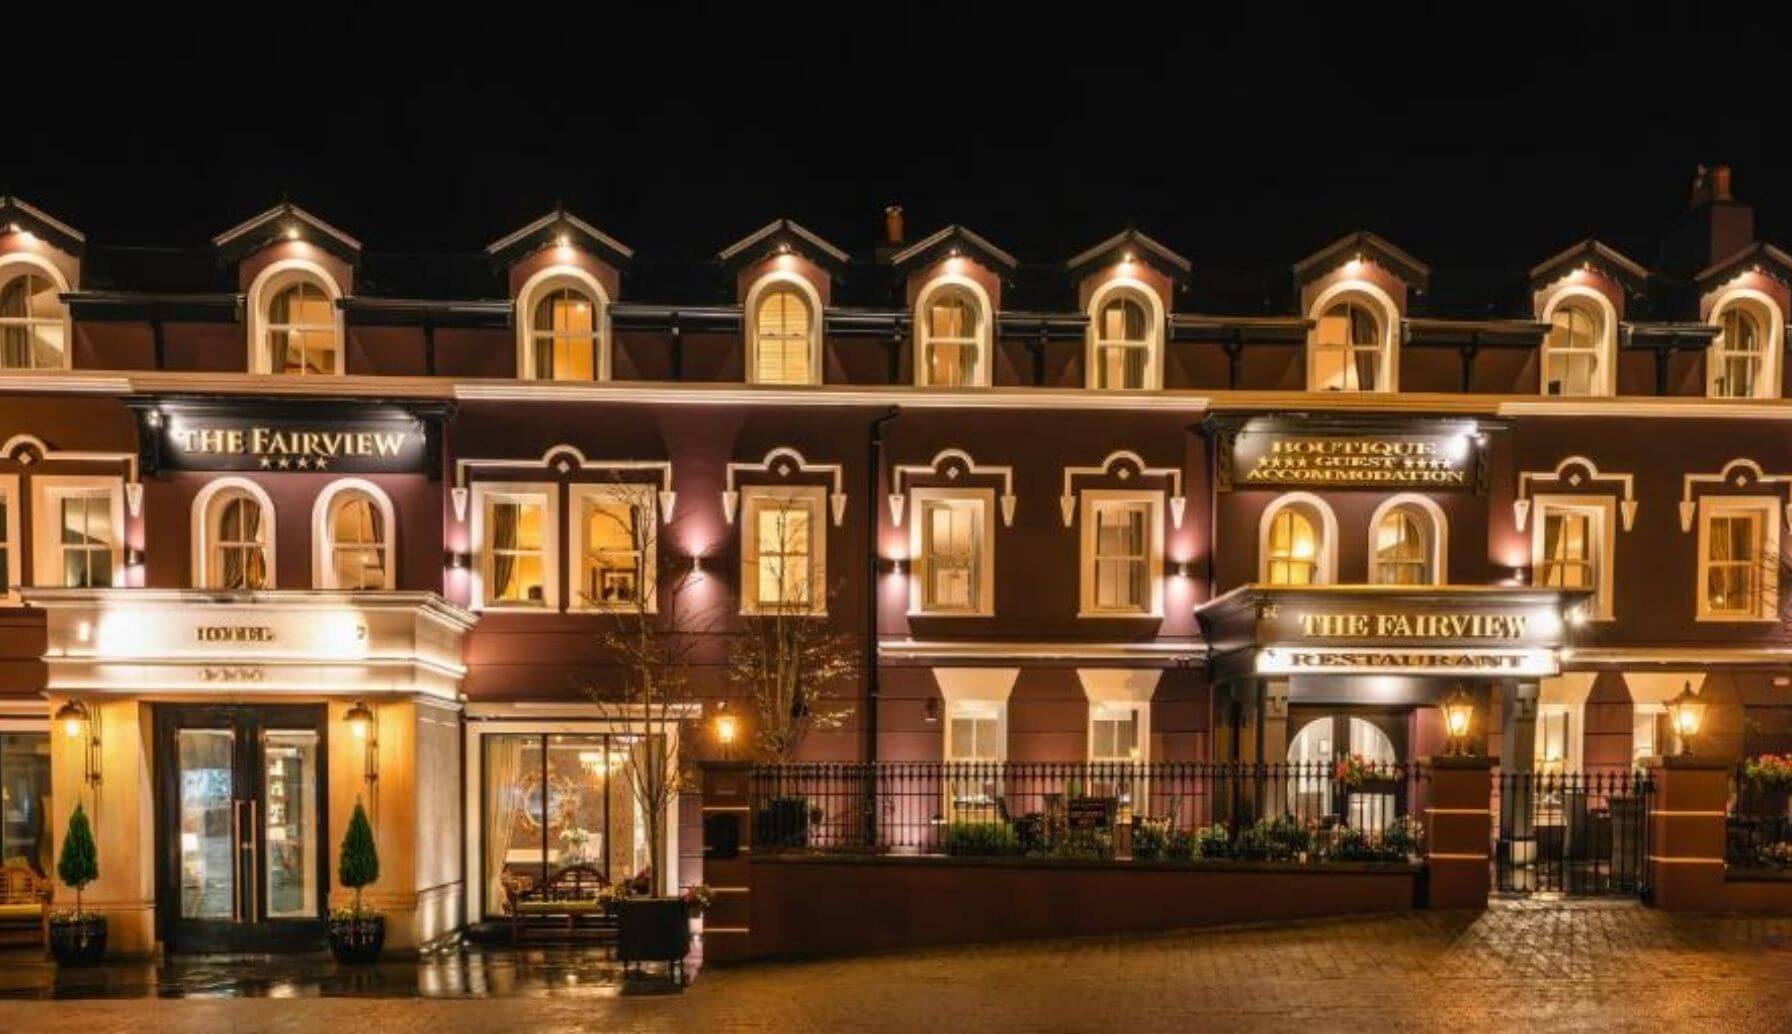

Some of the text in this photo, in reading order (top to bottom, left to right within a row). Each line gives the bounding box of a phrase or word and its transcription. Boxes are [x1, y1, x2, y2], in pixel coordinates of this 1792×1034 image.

[183, 428, 406, 456] THE FAIRVIEW
[1272, 440, 1438, 456] BOUTIQUE
[1315, 456, 1396, 468] GUEST
[1247, 469, 1465, 482] ACCOMMODATION
[1299, 614, 1527, 637] THE FAIRVIEW
[1291, 653, 1526, 667] RESTAURANT
